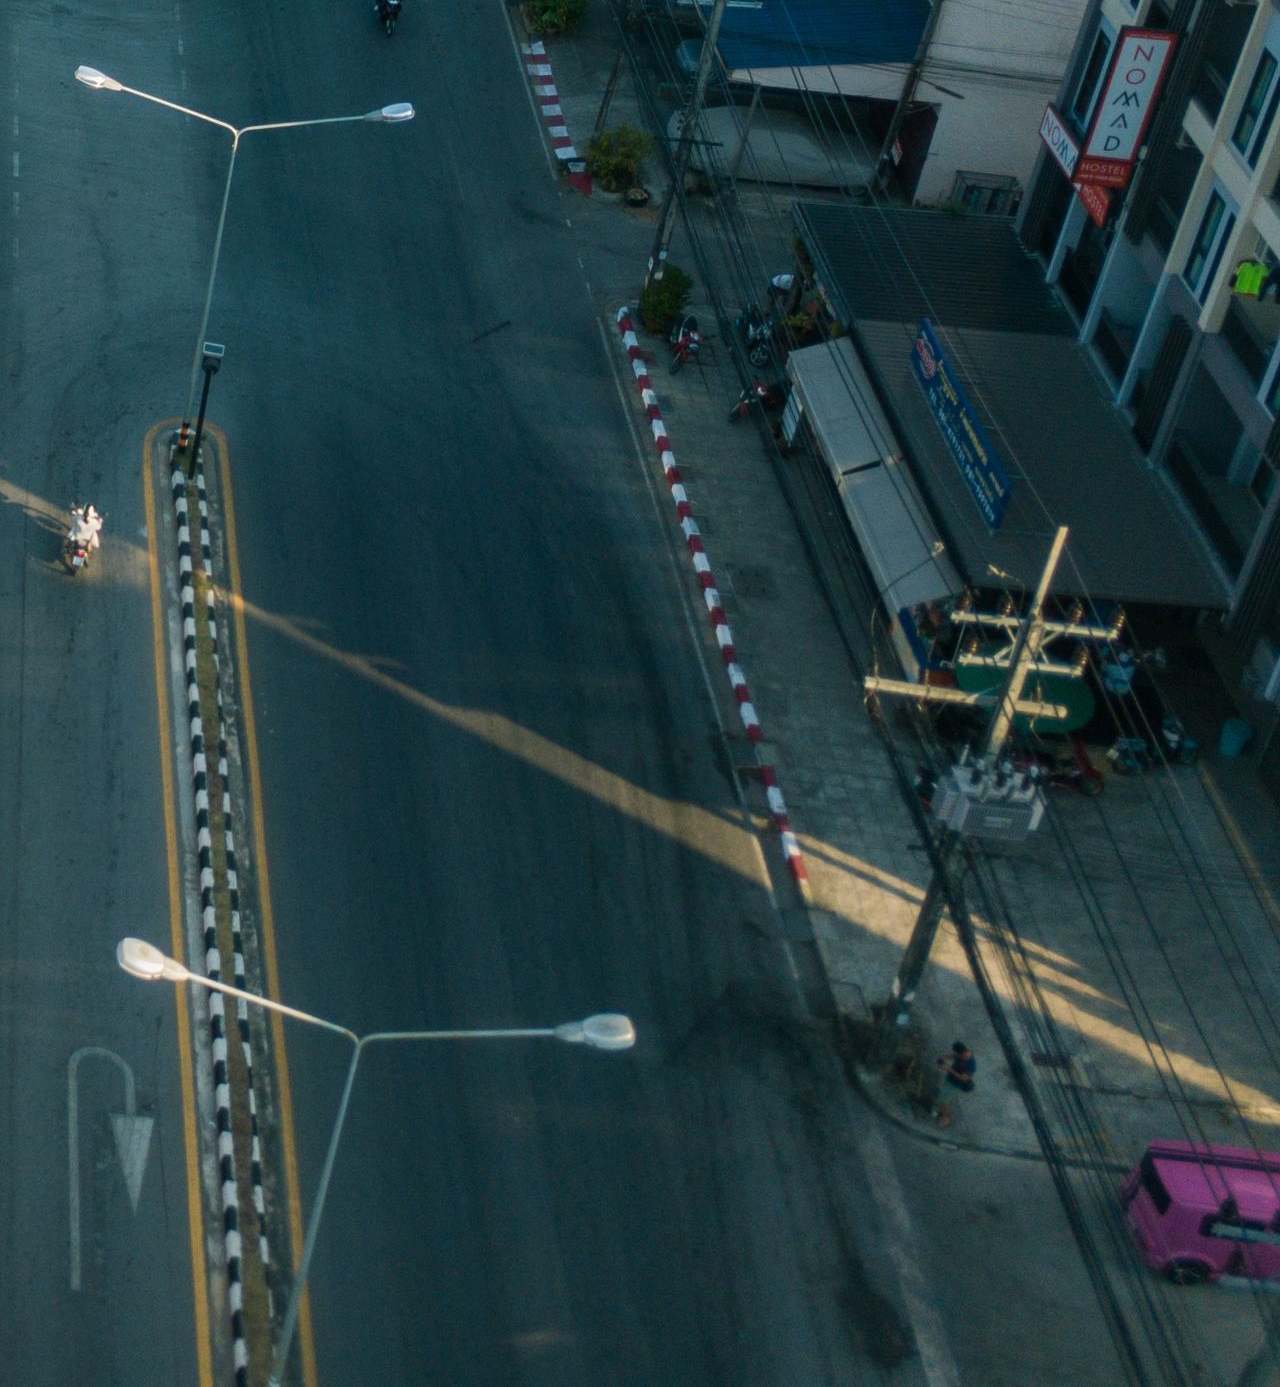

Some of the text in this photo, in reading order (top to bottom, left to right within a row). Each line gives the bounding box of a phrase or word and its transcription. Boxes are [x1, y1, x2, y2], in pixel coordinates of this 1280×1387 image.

[1104, 45, 1154, 152] NOMAD
[1043, 115, 1076, 173] NOMA
[1080, 163, 1125, 176] HOSTEL
